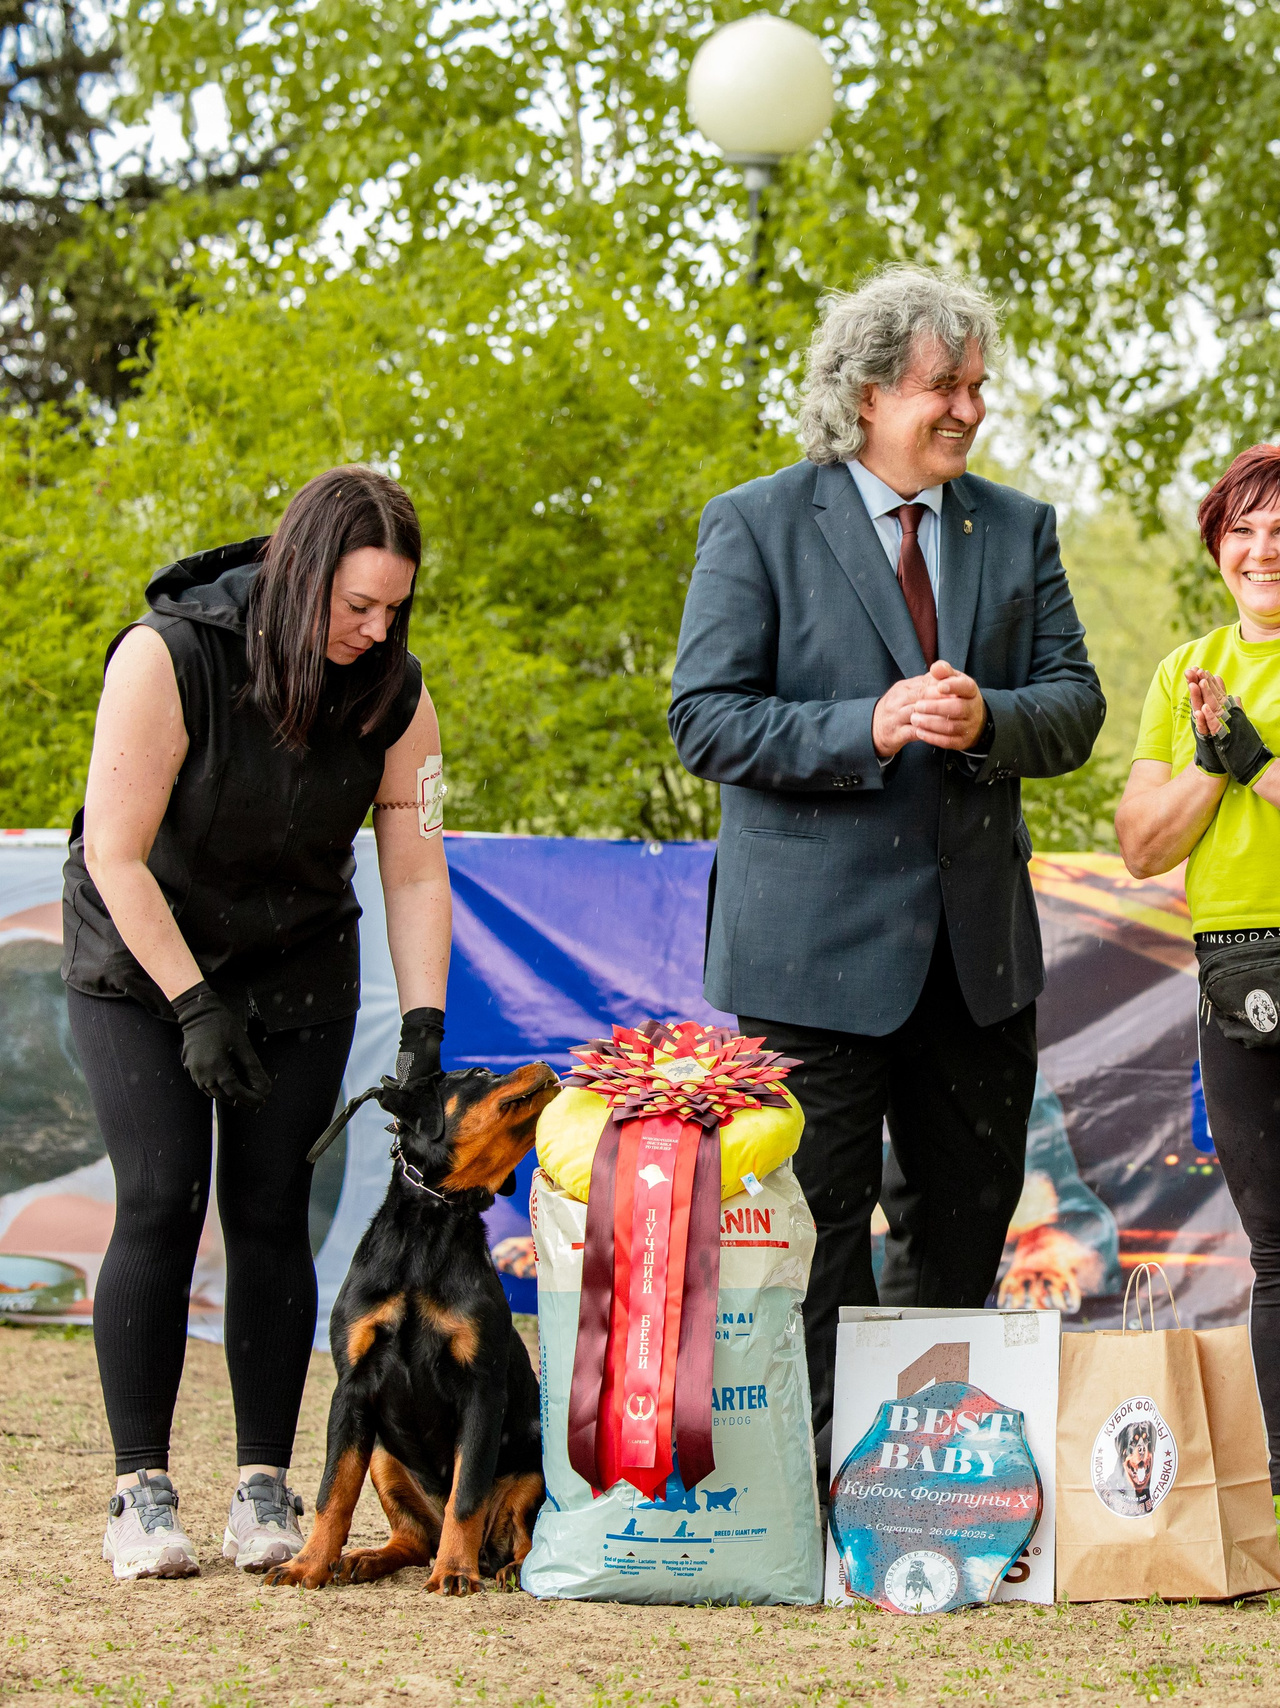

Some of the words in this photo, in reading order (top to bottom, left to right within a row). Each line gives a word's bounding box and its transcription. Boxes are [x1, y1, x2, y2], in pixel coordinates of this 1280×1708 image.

[720, 1207, 772, 1234] NIN
[642, 1208, 658, 1294] ЛУЧШИЙ
[637, 1314, 651, 1370] БЕБИ
[885, 1405, 1014, 1440] BEST
[1104, 1402, 1134, 1437] КУБОК
[877, 1442, 1007, 1478] BABY
[842, 1479, 907, 1499] Кубок
[910, 1485, 1011, 1509] Фортуны
[875, 1523, 923, 1535] Саратов
[929, 1527, 987, 1540] 26.04.2025
